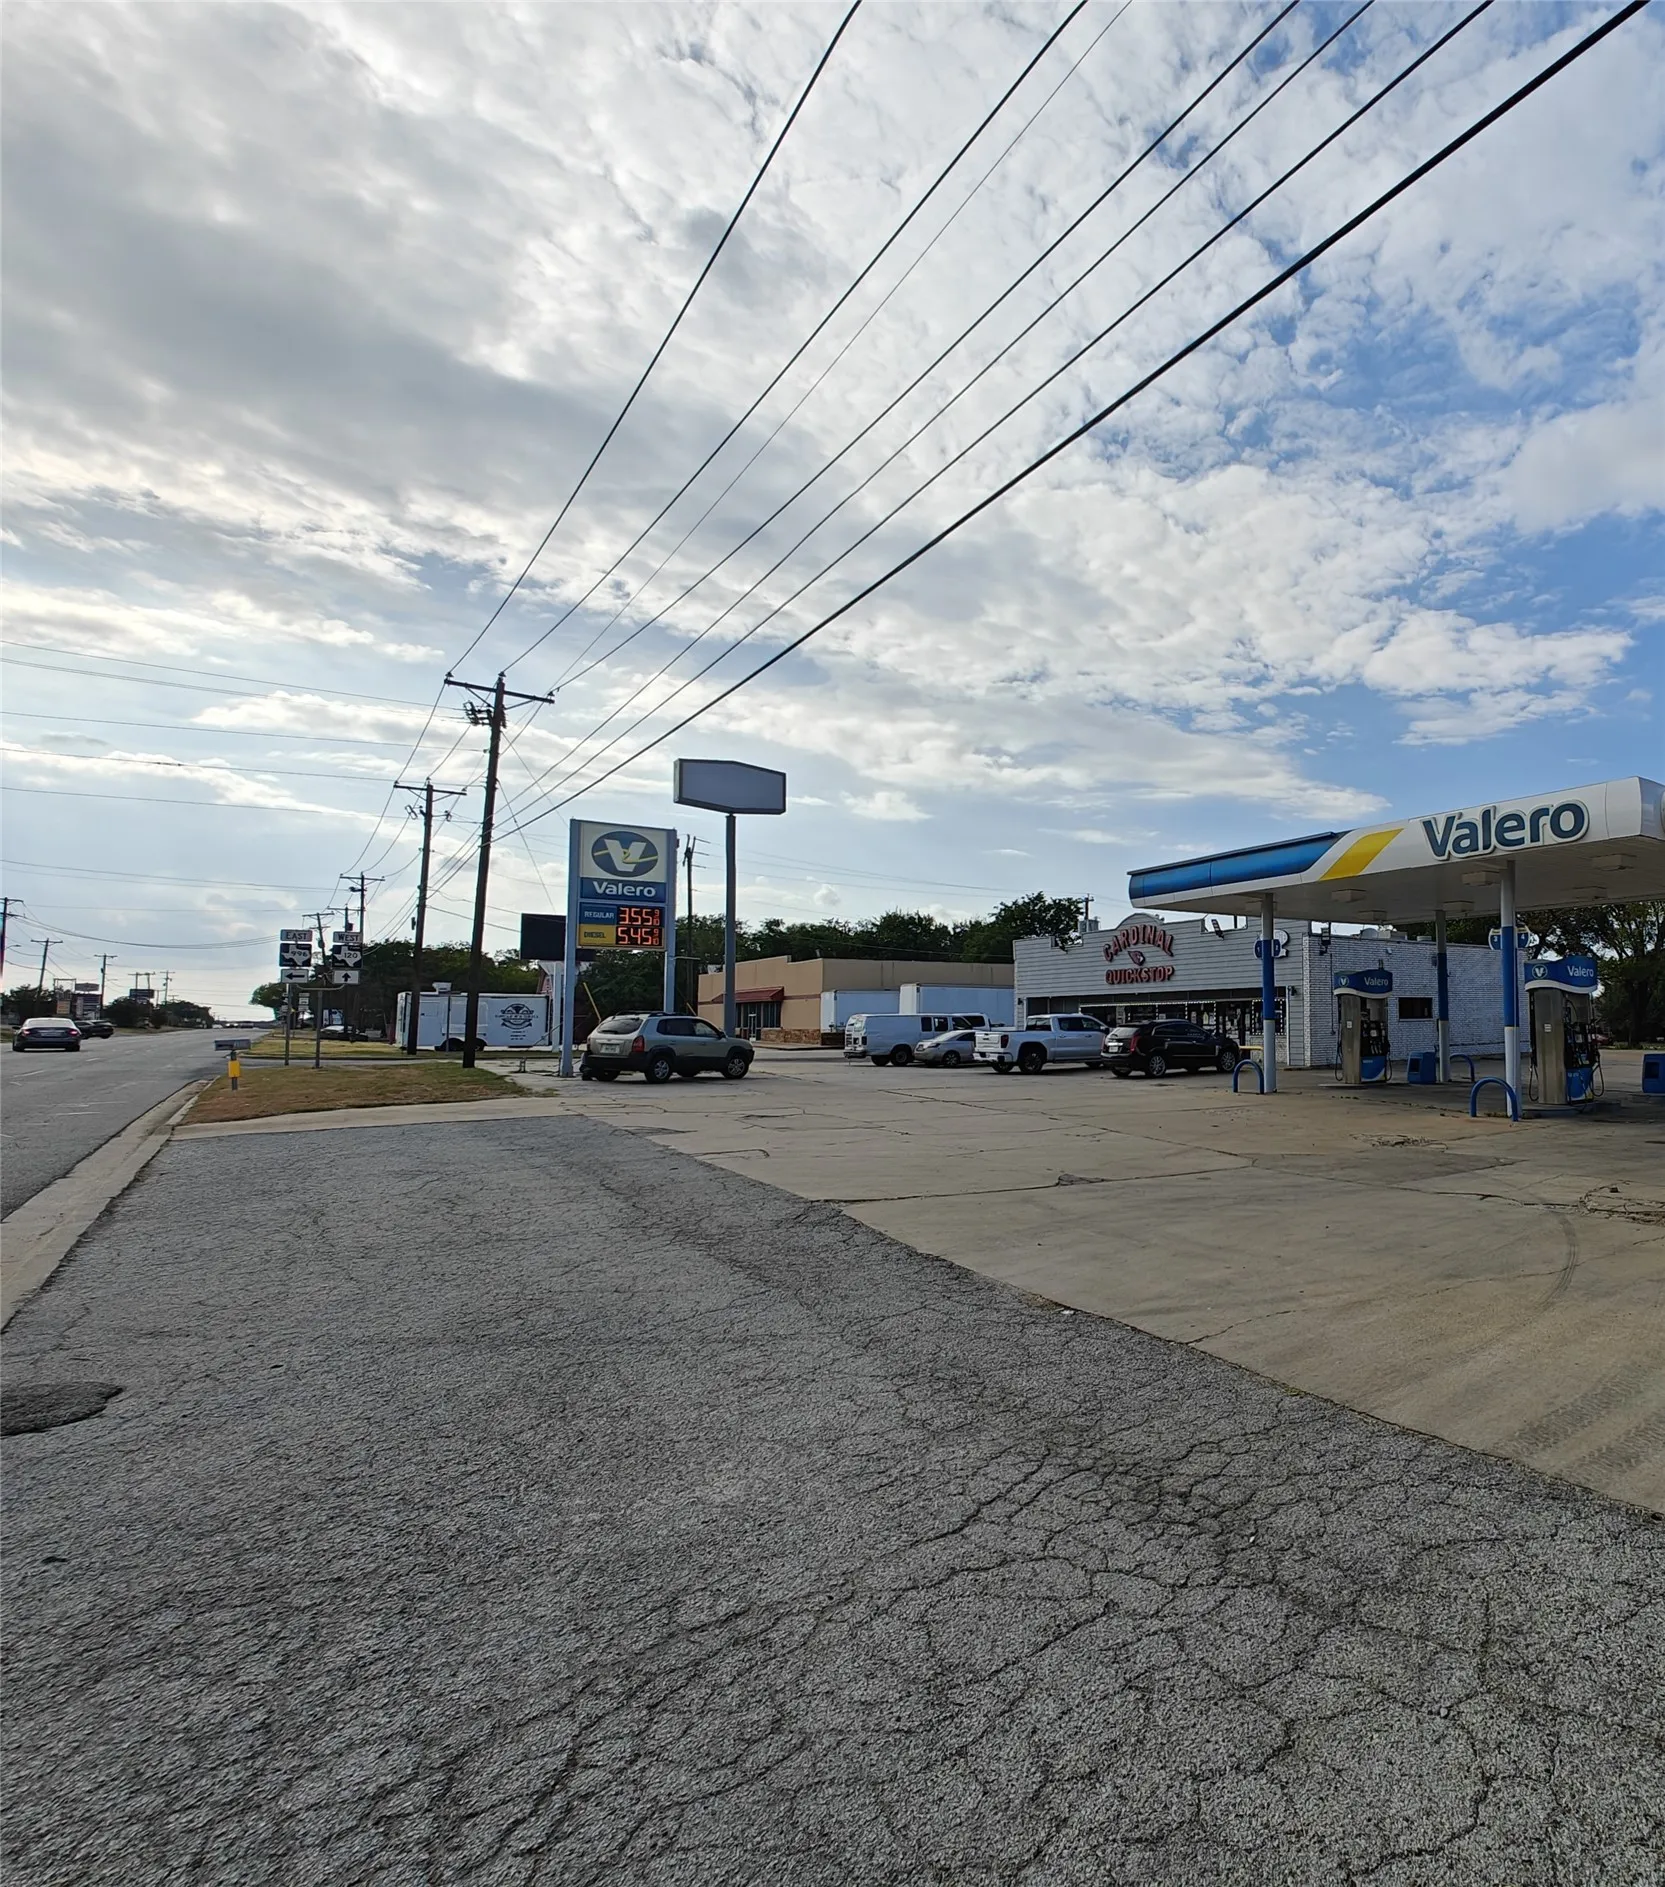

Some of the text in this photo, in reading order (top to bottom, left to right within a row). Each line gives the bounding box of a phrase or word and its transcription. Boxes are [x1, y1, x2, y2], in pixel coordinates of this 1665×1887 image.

[1422, 802, 1586, 858] Valero
[592, 880, 657, 898] Valero
[584, 911, 615, 919] REGULAR
[619, 907, 653, 926] 3.55
[286, 931, 308, 940] EAST
[338, 933, 359, 941] WEST
[617, 927, 652, 945] 5.45
[1103, 924, 1175, 963] CARDINAL
[1105, 966, 1176, 985] QUICKSTOP
[1567, 965, 1594, 977] Valero
[1364, 976, 1389, 986] Valero
